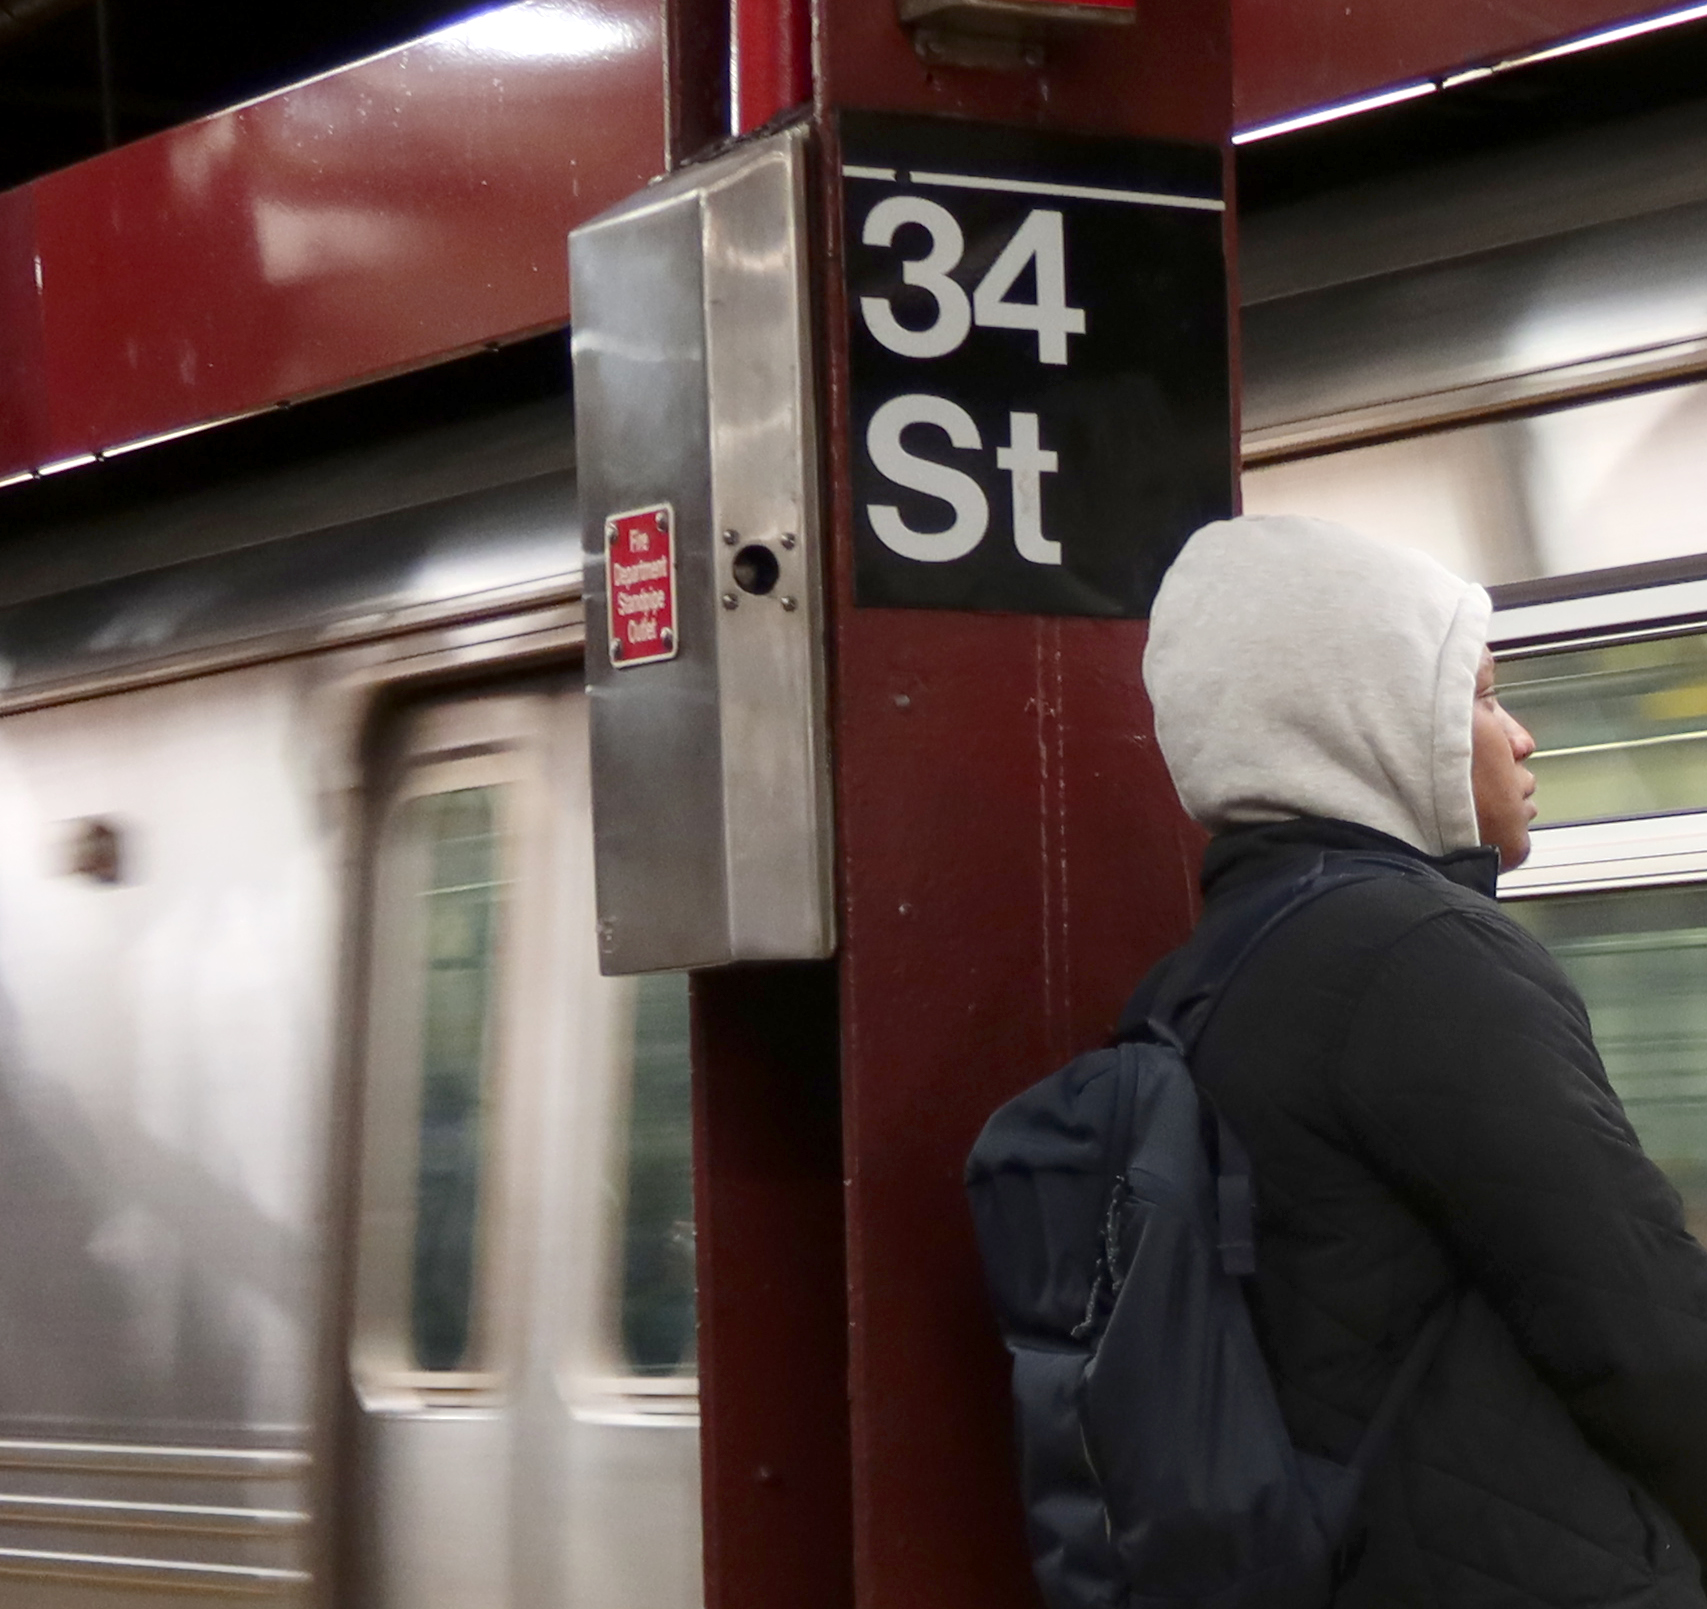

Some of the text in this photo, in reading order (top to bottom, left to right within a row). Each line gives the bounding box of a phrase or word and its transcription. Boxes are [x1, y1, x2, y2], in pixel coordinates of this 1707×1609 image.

[860, 196, 1086, 365] 34
[866, 394, 1062, 565] St
[629, 529, 650, 553] Fire
[614, 555, 668, 590] Department
[618, 586, 666, 617] Standpipe
[627, 617, 657, 644] Outlet
